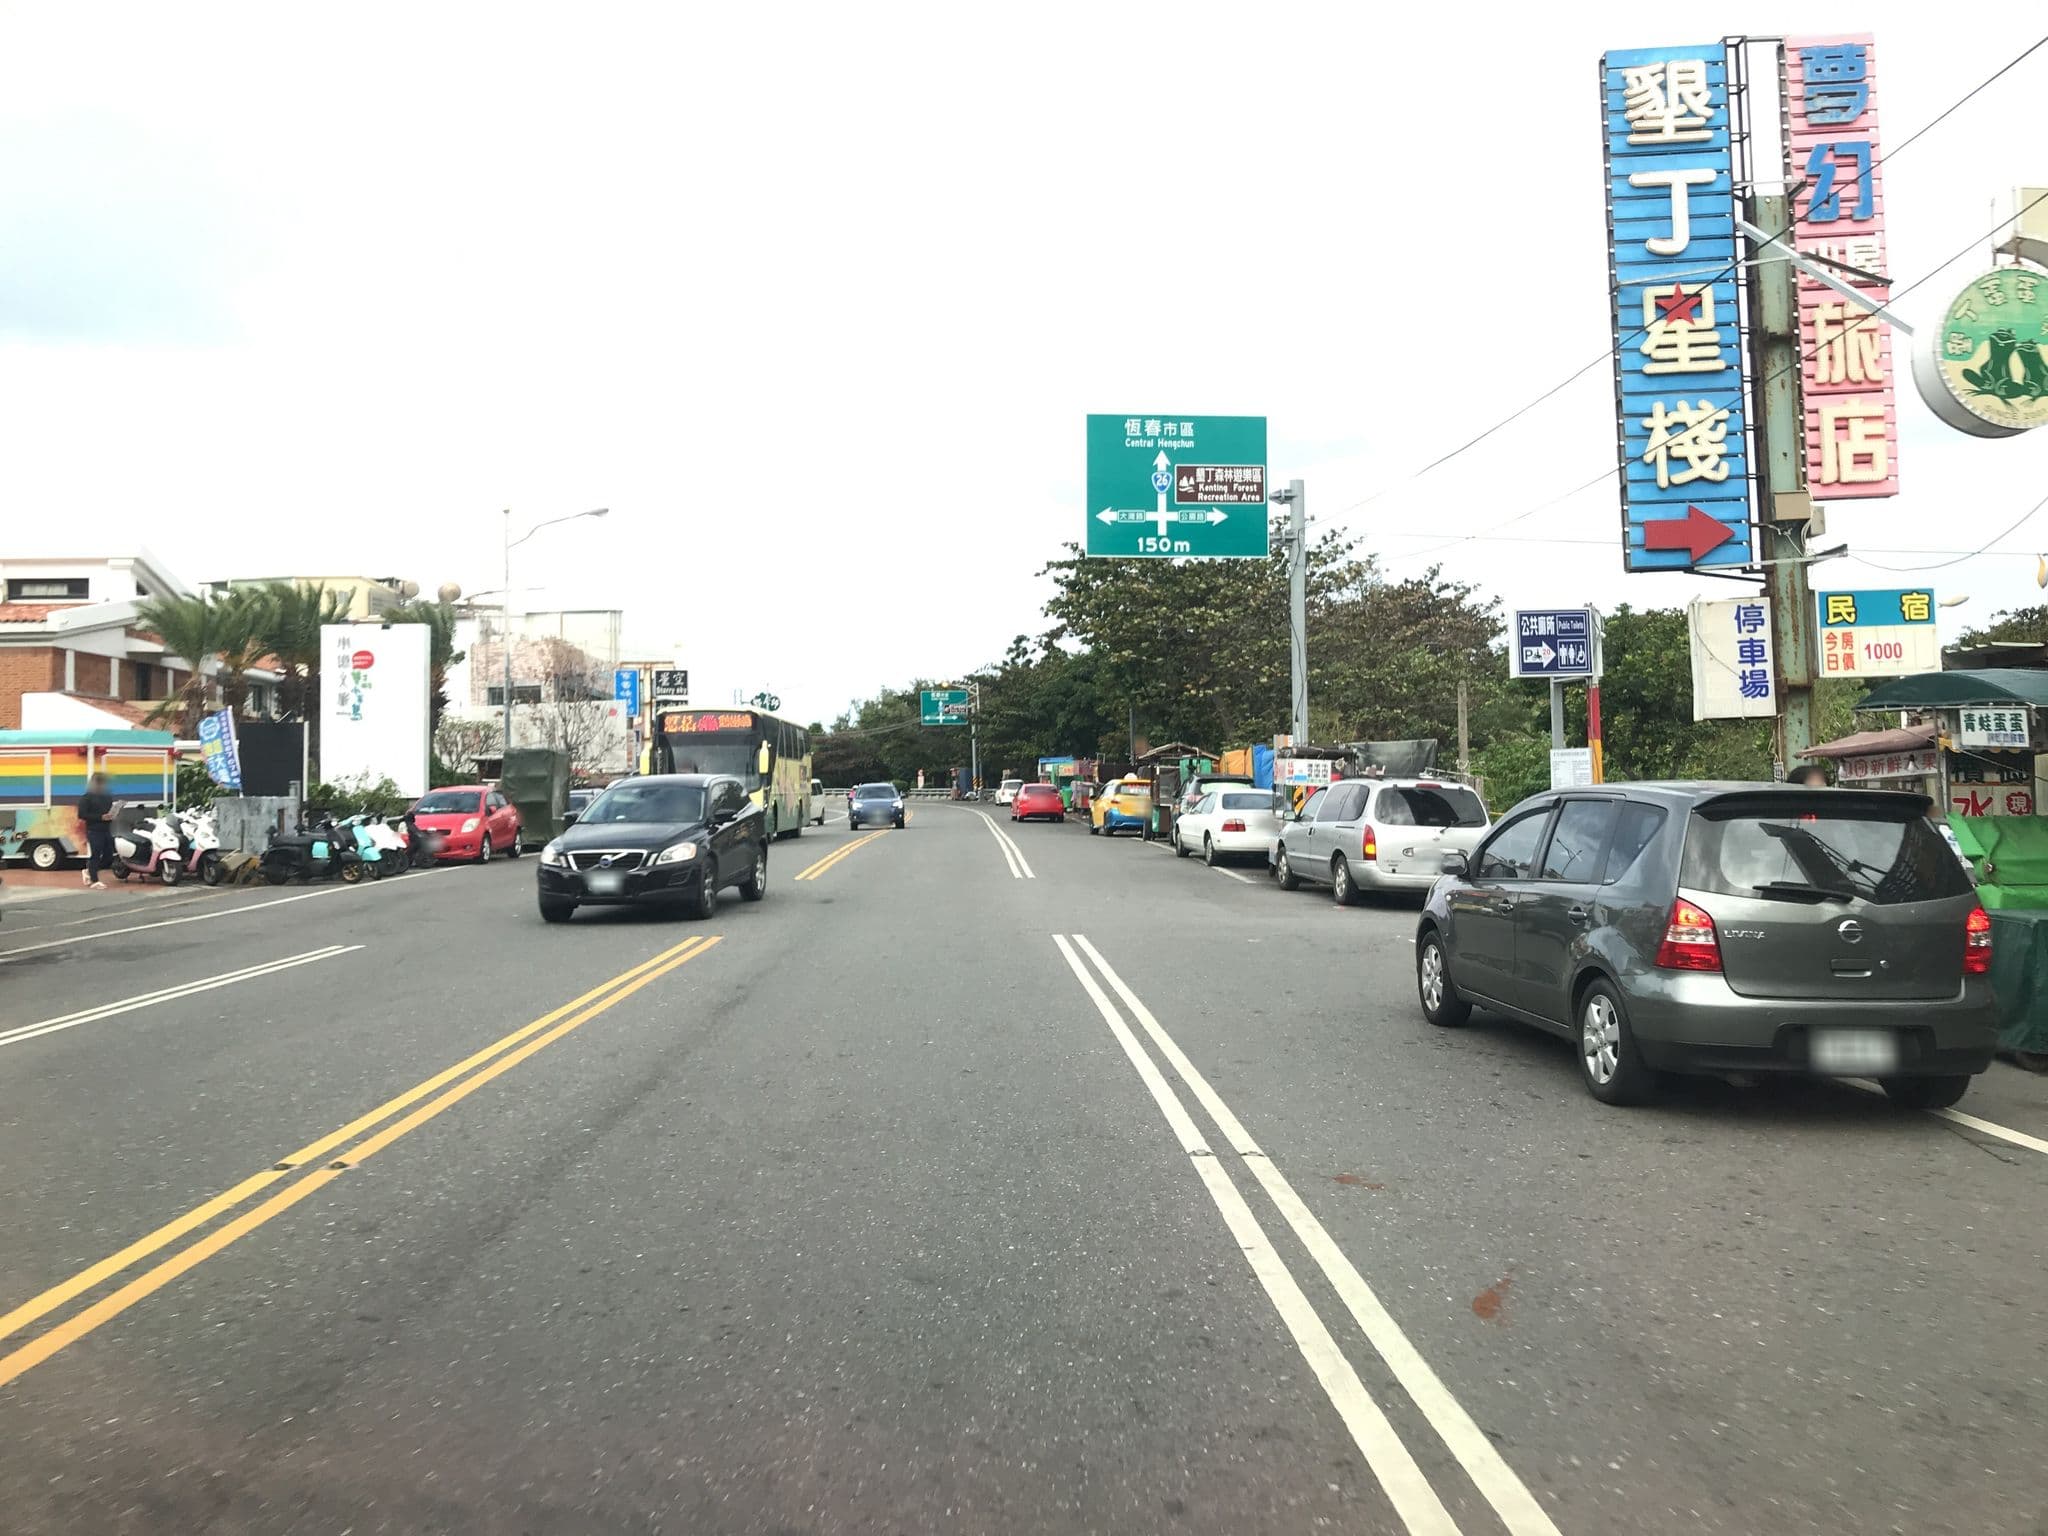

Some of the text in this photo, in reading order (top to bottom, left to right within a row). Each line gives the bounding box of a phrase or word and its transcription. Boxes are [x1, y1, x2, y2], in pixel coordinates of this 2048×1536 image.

[1124, 418, 1194, 437] 恆春市區
[1125, 438, 1194, 450] Central Hengchun
[1156, 474, 1168, 486] 26
[1198, 484, 1257, 493] Kenting Forest
[1198, 493, 1260, 501] Recreation Area
[1521, 615, 1555, 636] 公共廁所
[1525, 649, 1533, 660] P
[1734, 604, 1769, 699] 停車場
[1865, 642, 1903, 660] 1000
